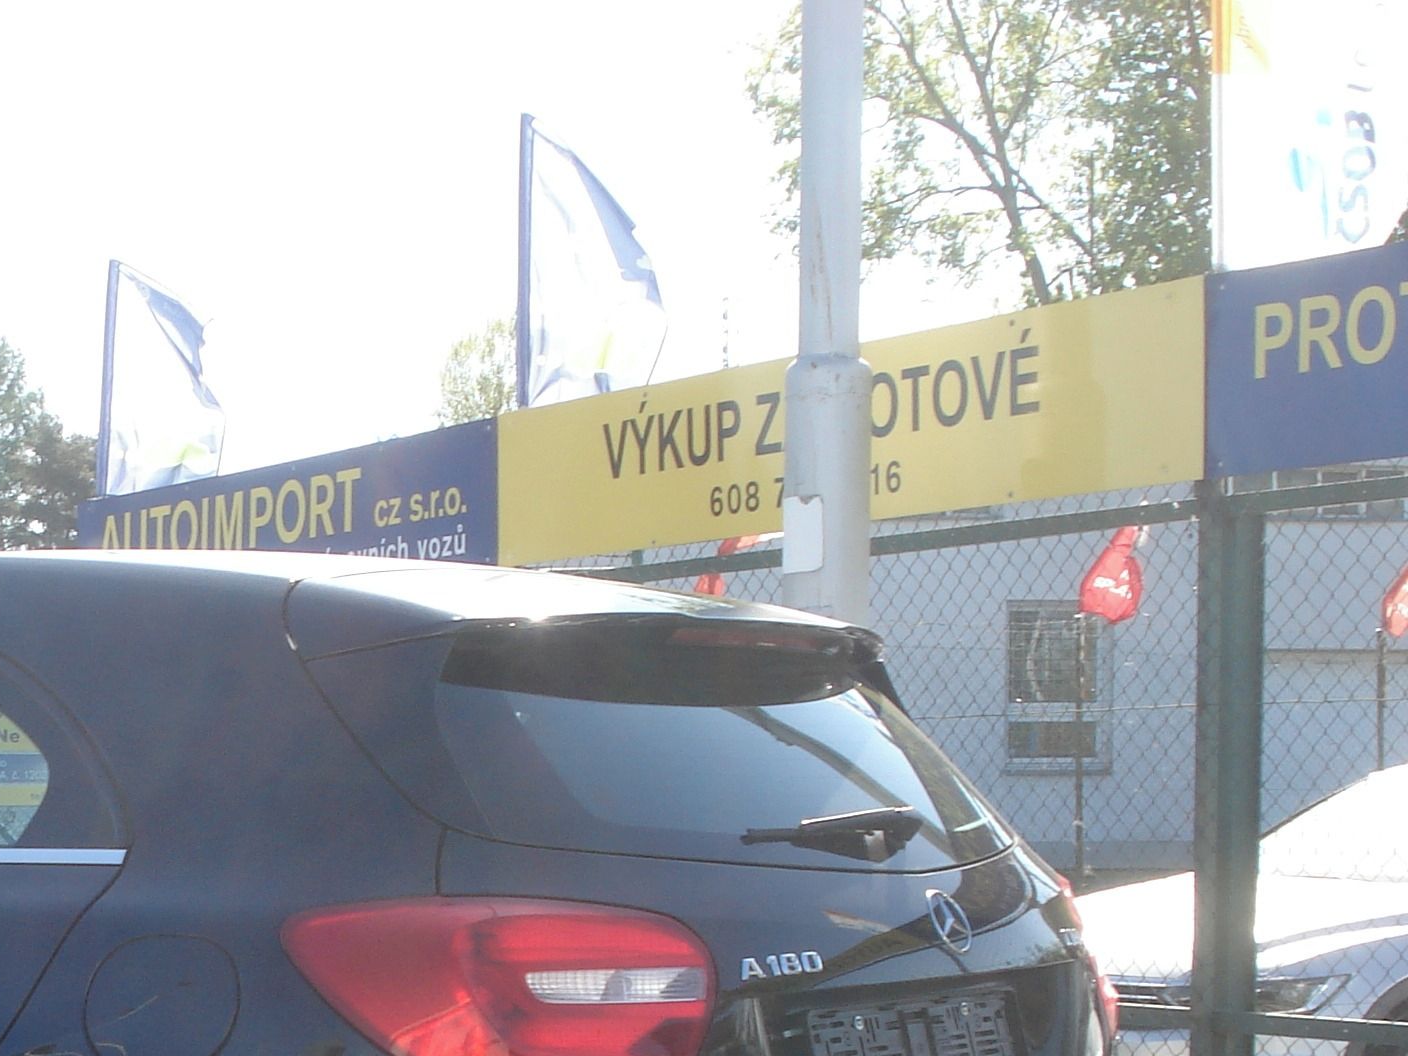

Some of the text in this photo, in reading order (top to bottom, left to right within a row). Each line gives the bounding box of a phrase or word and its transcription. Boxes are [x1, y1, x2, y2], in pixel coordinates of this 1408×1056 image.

[603, 329, 1041, 480] VÝKUP Z OTOVÉ
[102, 467, 362, 551] AUTOIMPORT
[374, 497, 401, 528] cz
[409, 486, 468, 523] s.r.o.
[709, 480, 760, 518] 608
[870, 460, 902, 496] 16
[417, 524, 467, 559] vozů
